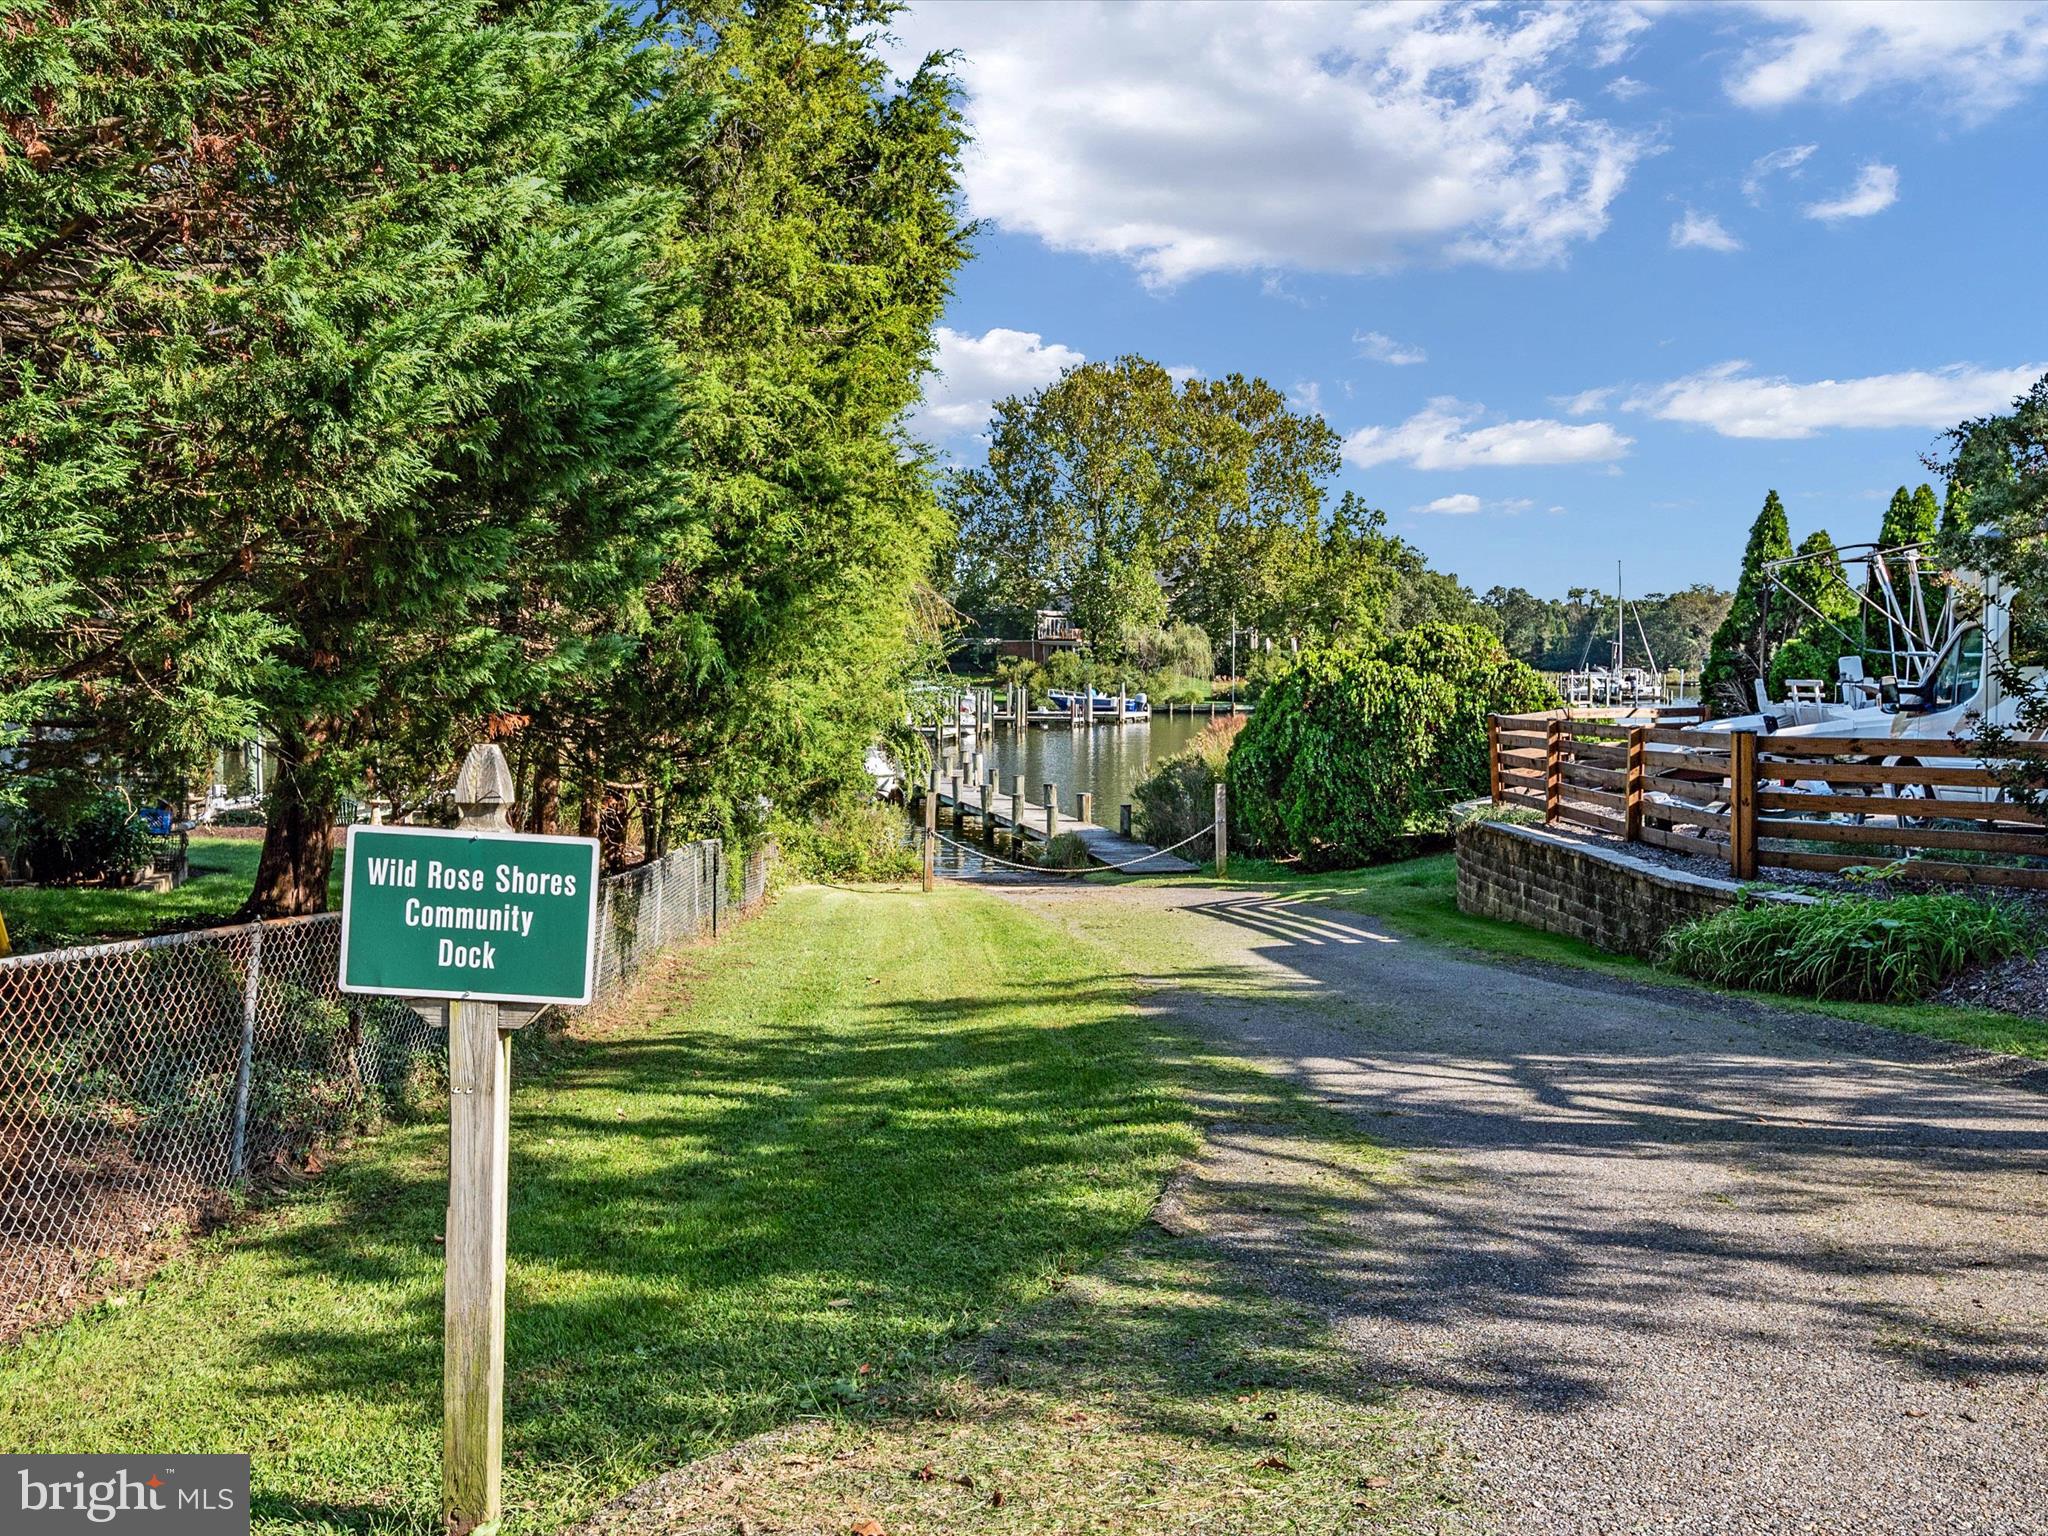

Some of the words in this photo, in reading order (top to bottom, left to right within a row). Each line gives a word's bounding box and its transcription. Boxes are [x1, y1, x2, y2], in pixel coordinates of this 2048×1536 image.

[368, 857, 417, 888] Wild
[427, 861, 484, 892] Rose
[495, 864, 576, 896] Shores
[405, 898, 534, 936] Community
[438, 939, 496, 970] Dock
